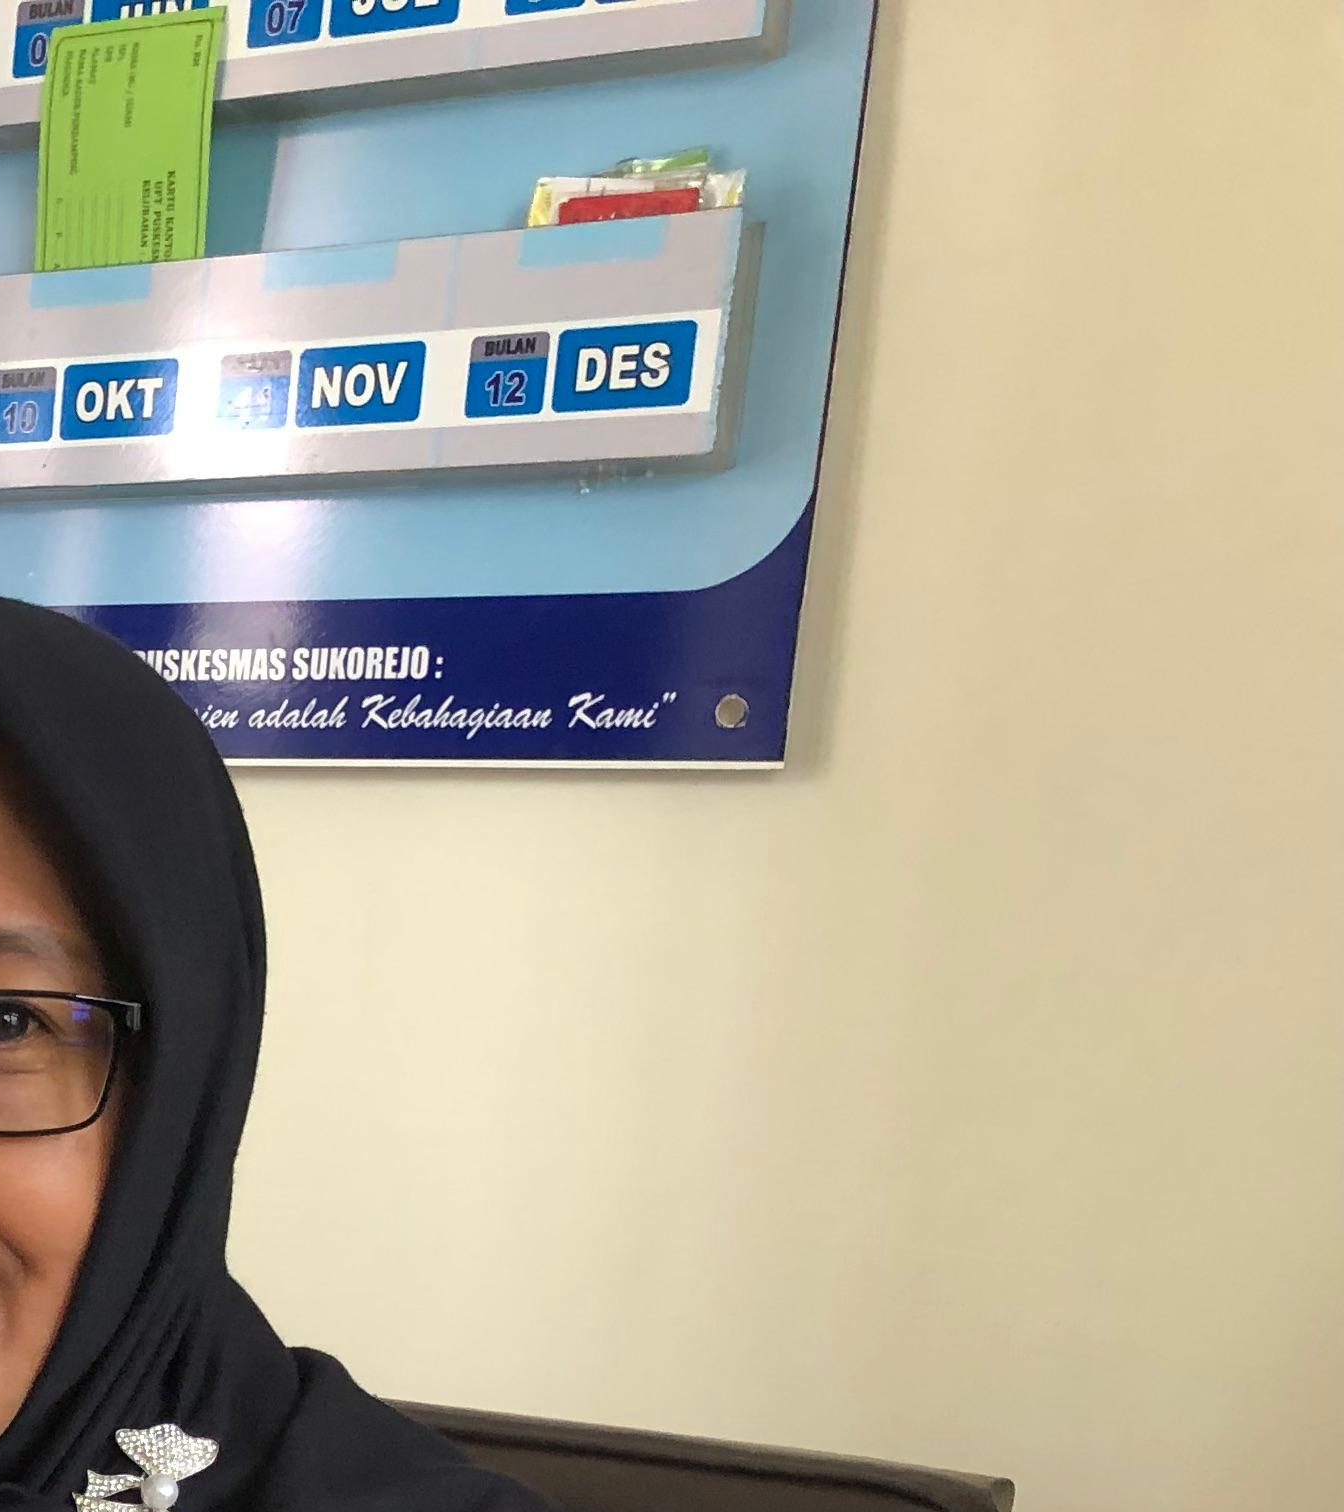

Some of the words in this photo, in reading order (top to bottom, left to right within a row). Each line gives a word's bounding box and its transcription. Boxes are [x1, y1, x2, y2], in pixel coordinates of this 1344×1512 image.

[266, 2, 300, 36] 07
[483, 336, 537, 357] BULAN
[311, 360, 408, 409] NOV
[573, 341, 672, 393] DES
[75, 377, 164, 422] OKT
[485, 370, 529, 407] 12
[4, 400, 39, 435] 10
[133, 647, 287, 682] USKESMAS
[292, 645, 428, 682] SUKOREJO
[194, 704, 240, 729] ien
[249, 695, 348, 730] adalah
[360, 694, 552, 741] Kebahagiaan
